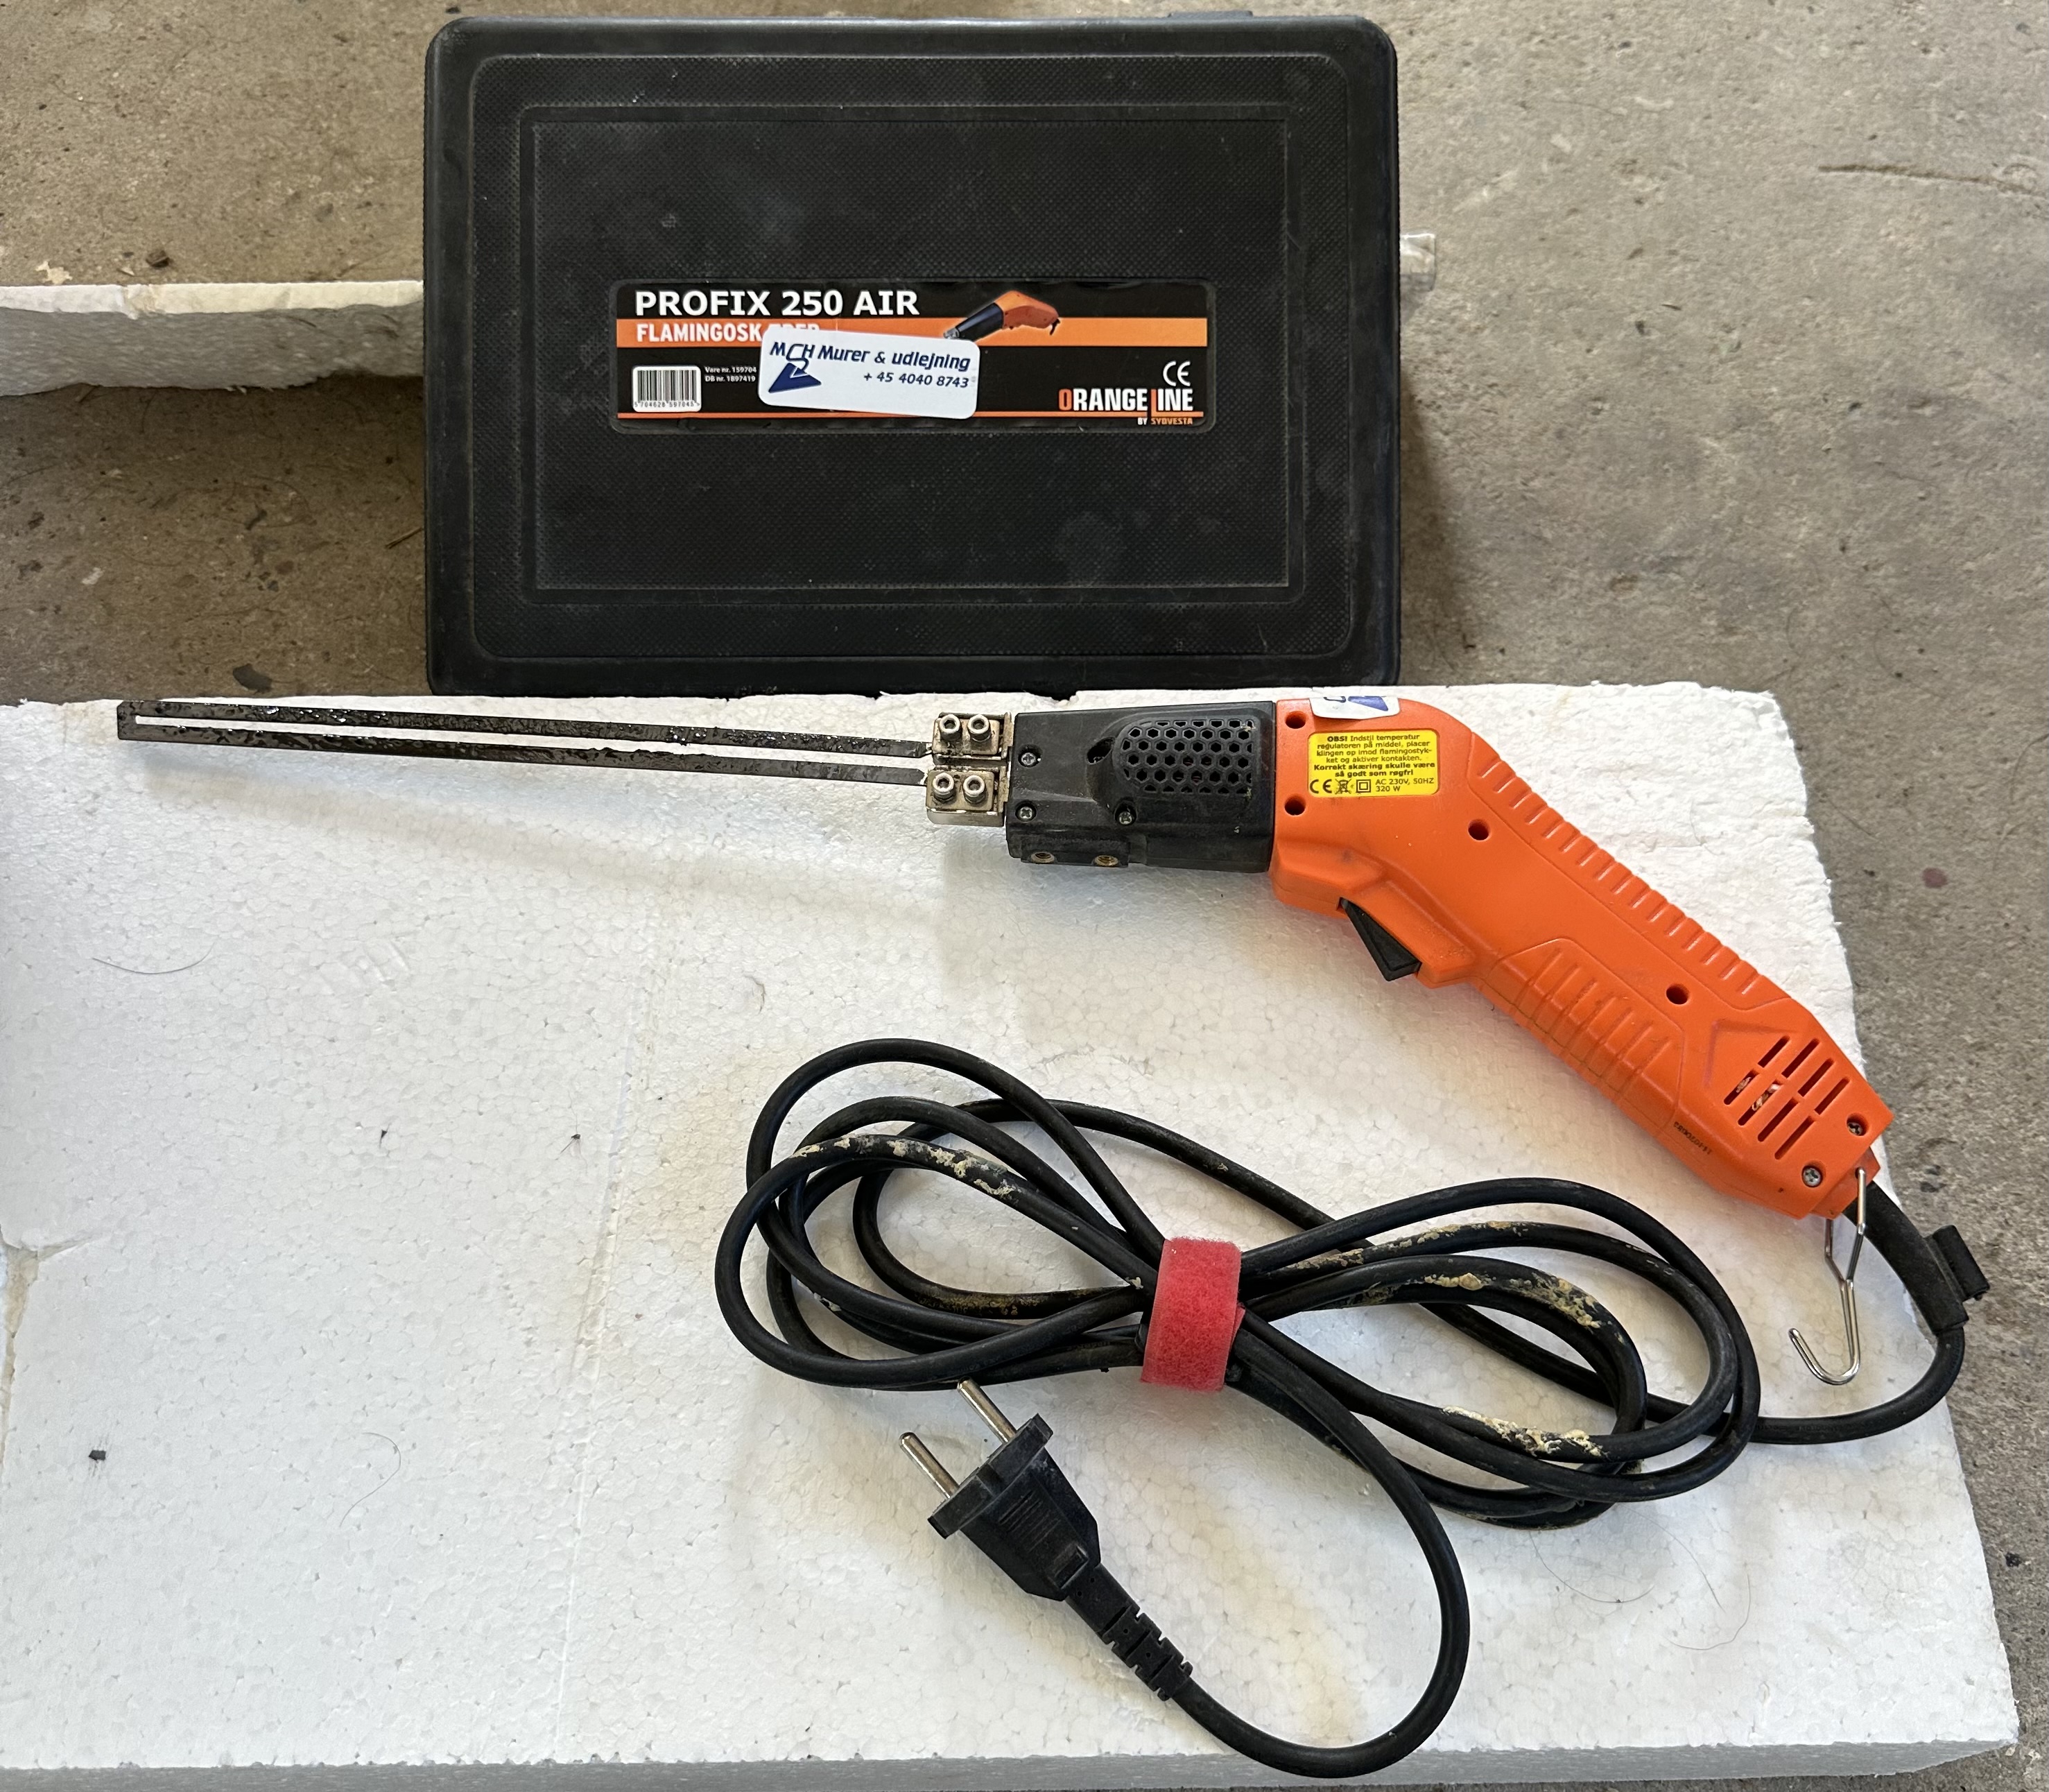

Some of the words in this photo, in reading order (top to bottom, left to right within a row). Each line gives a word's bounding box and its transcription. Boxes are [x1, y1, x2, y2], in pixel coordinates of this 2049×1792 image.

[636, 291, 770, 316] PROFIX
[781, 290, 843, 316] 250
[853, 290, 920, 316] AIR
[637, 323, 820, 342] FLAMINGOSK
[818, 345, 870, 362] Murer
[874, 351, 885, 364] &
[892, 352, 971, 372] udlejning
[876, 372, 894, 382] 45
[899, 373, 933, 386] 4040
[936, 376, 969, 388] 8743
[1364, 741, 1373, 749] på
